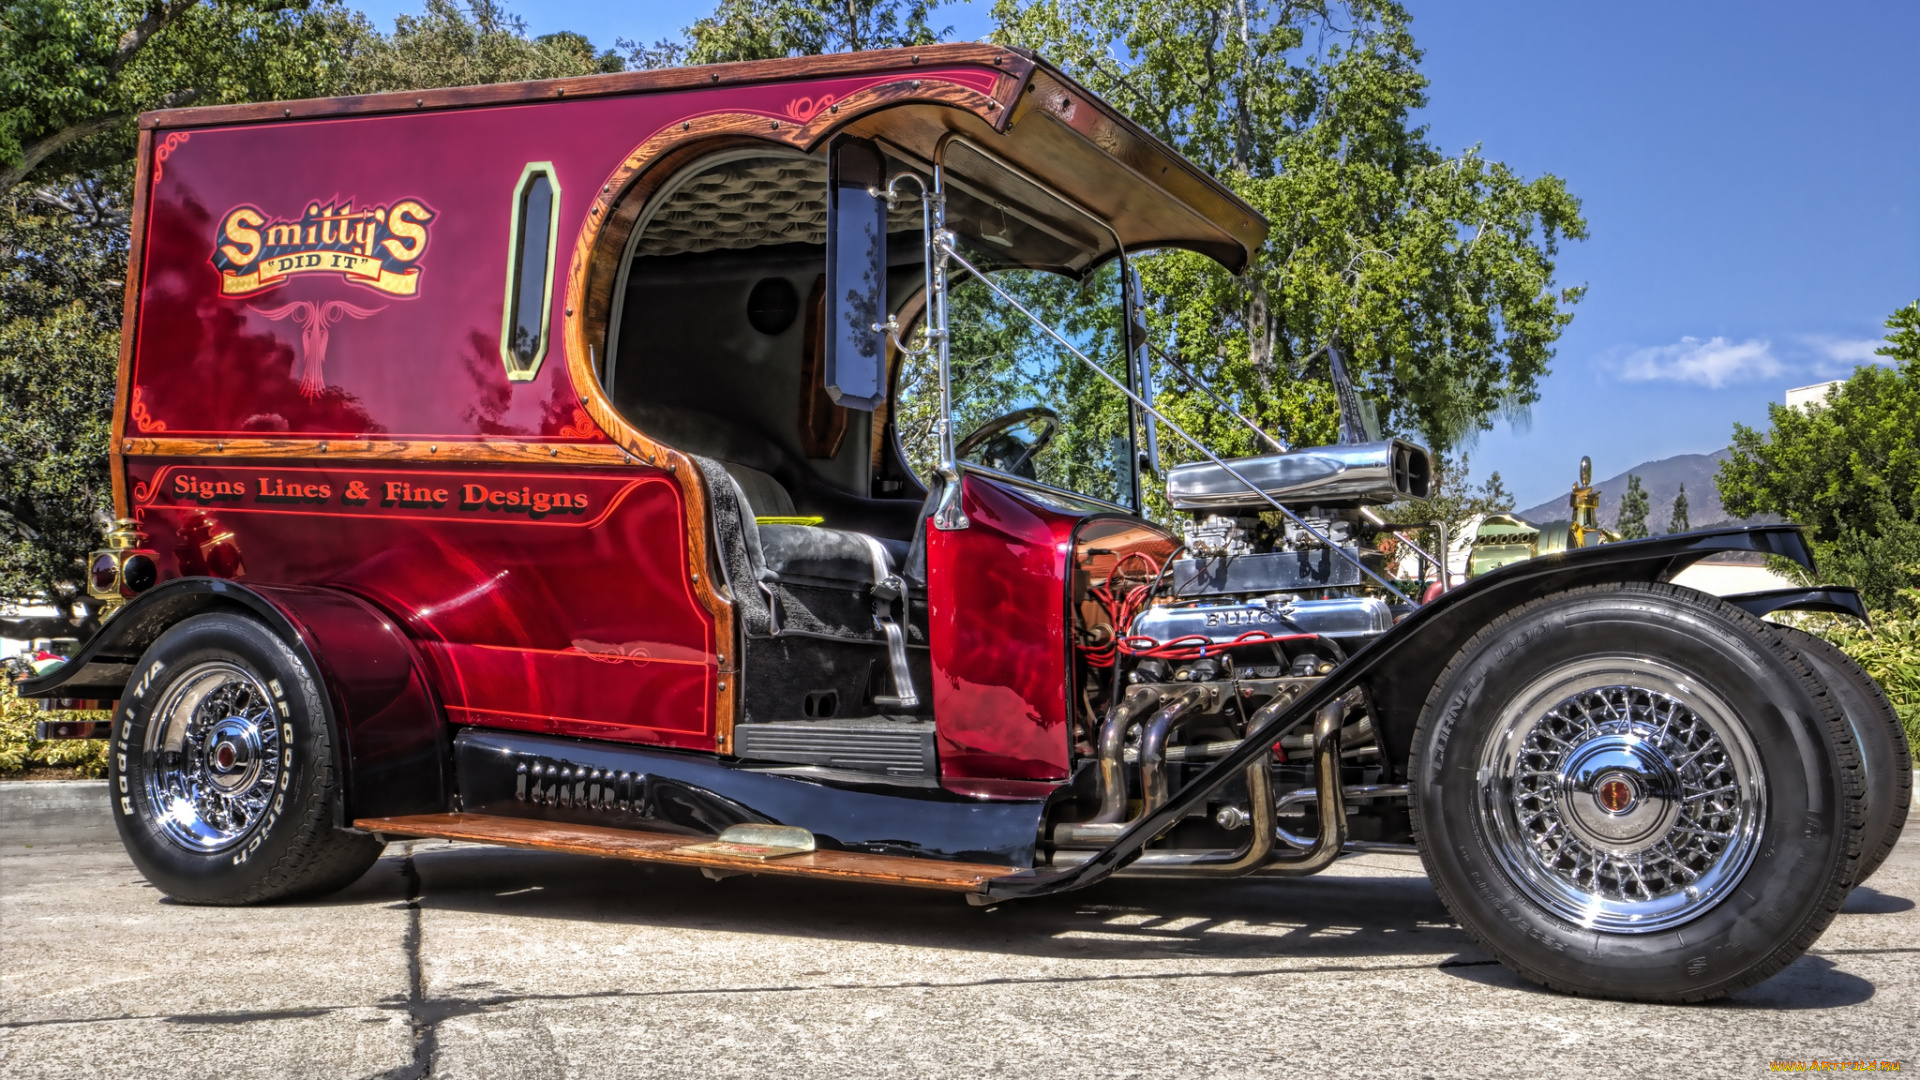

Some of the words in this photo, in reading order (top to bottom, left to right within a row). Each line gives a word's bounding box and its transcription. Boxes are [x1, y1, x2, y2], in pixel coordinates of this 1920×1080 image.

[174, 474, 246, 499] Signs
[258, 477, 331, 499] Lines
[345, 480, 370, 500] &
[385, 481, 449, 503] Fine
[462, 484, 589, 513] Designs
[1205, 607, 1296, 628] BUICK
[117, 707, 136, 816] Radial
[133, 660, 165, 700] T/A
[232, 678, 294, 866] BFGoodrich
